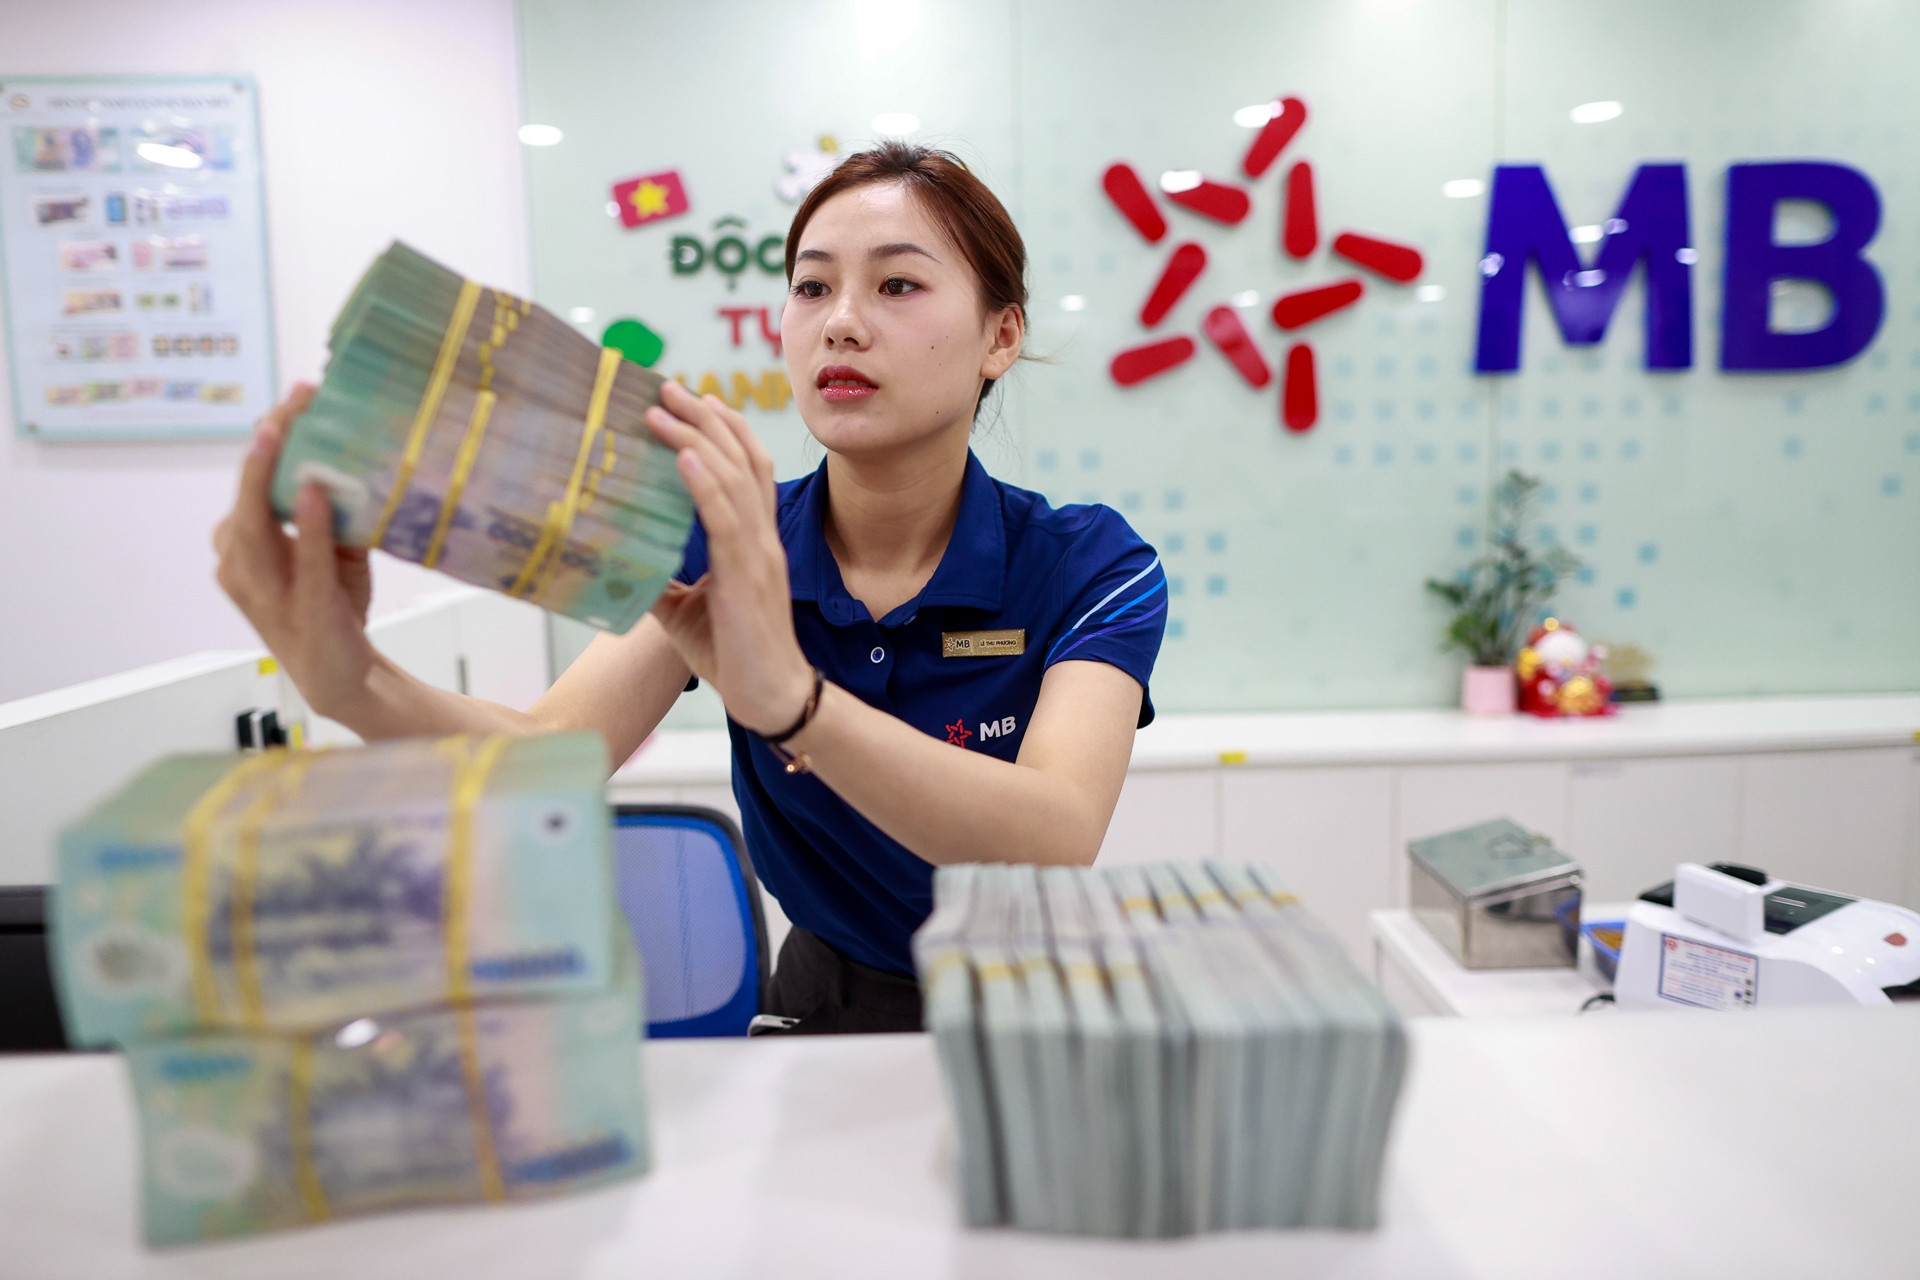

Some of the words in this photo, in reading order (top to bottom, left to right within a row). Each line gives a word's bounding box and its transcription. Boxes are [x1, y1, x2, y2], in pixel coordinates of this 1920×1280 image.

[669, 216, 786, 292] ĐỘC
[1472, 160, 1886, 374] MB
[956, 639, 970, 648] MB
[979, 716, 1017, 742] MB
